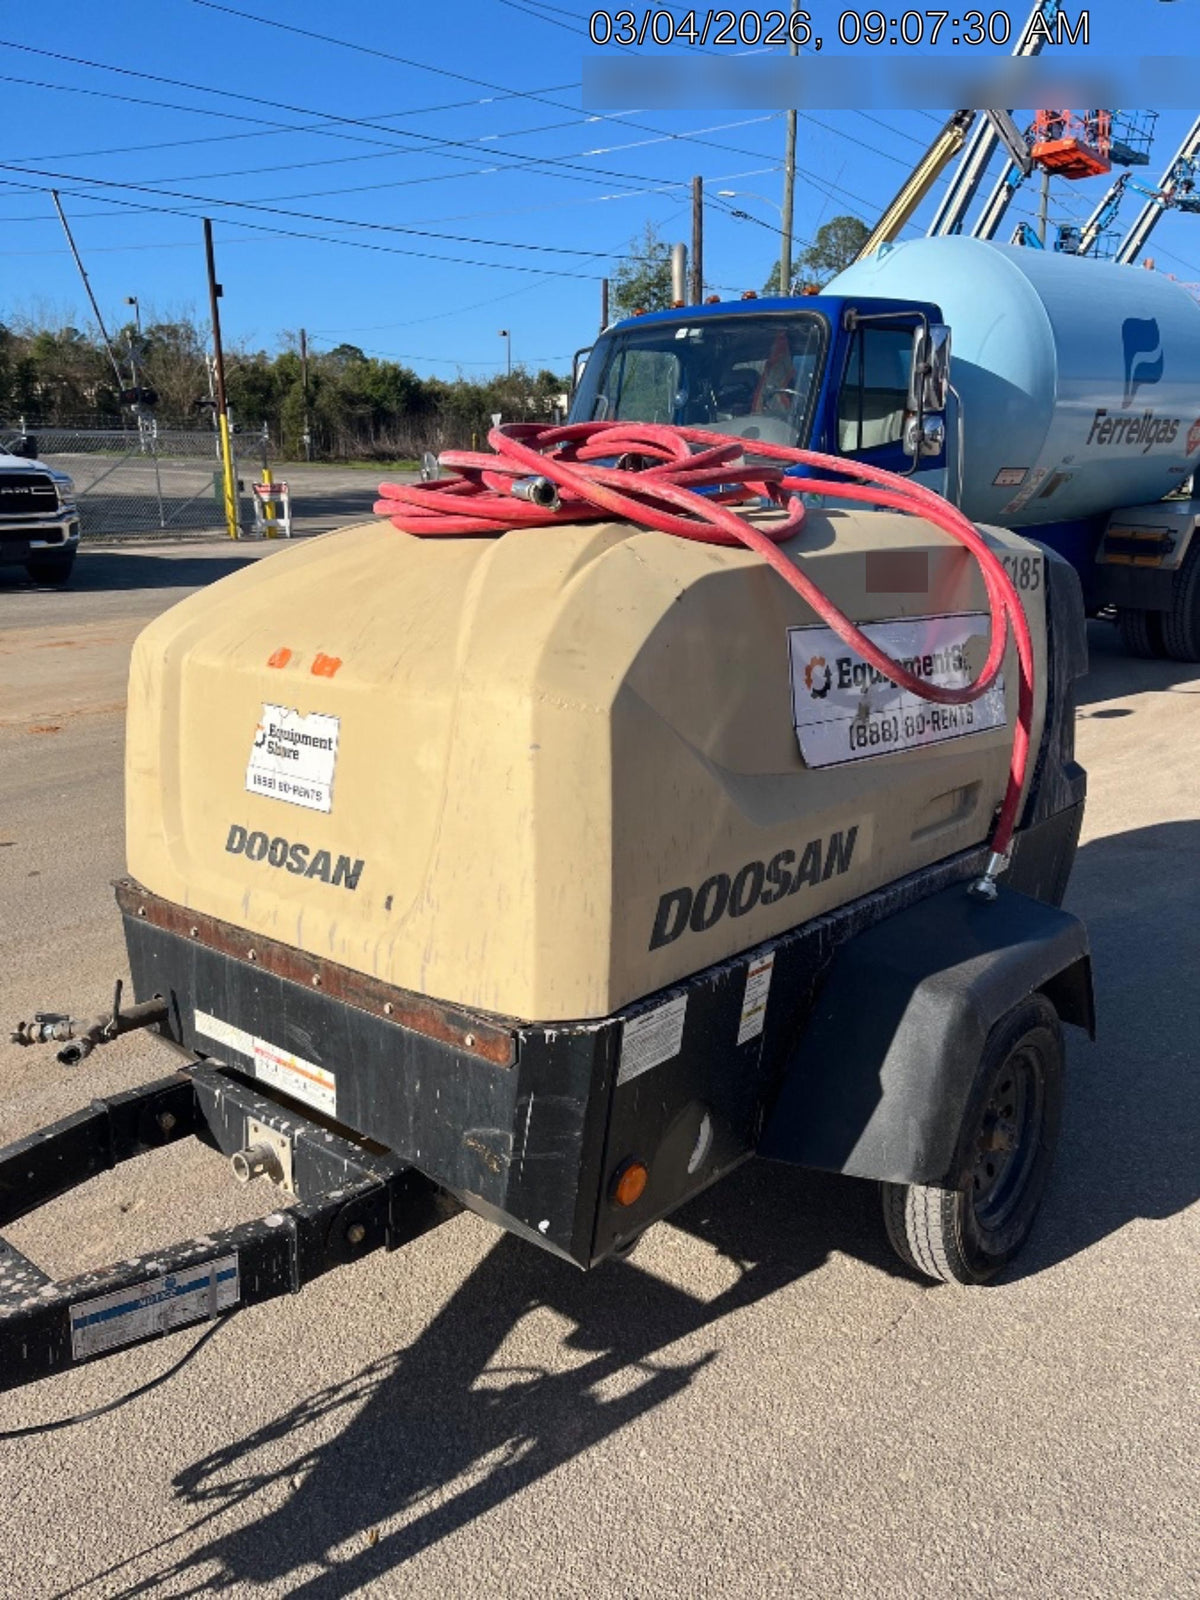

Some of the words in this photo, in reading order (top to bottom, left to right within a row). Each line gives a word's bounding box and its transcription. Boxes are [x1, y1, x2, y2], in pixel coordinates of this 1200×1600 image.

[1086, 408, 1180, 454] Ferrellgas
[267, 740, 299, 760] Share
[268, 723, 333, 751] Equipment
[850, 716, 898, 751] (888)
[904, 704, 974, 738] 80-RENTS
[225, 824, 365, 891] DOOSAN
[649, 825, 859, 950] DOOSAN
